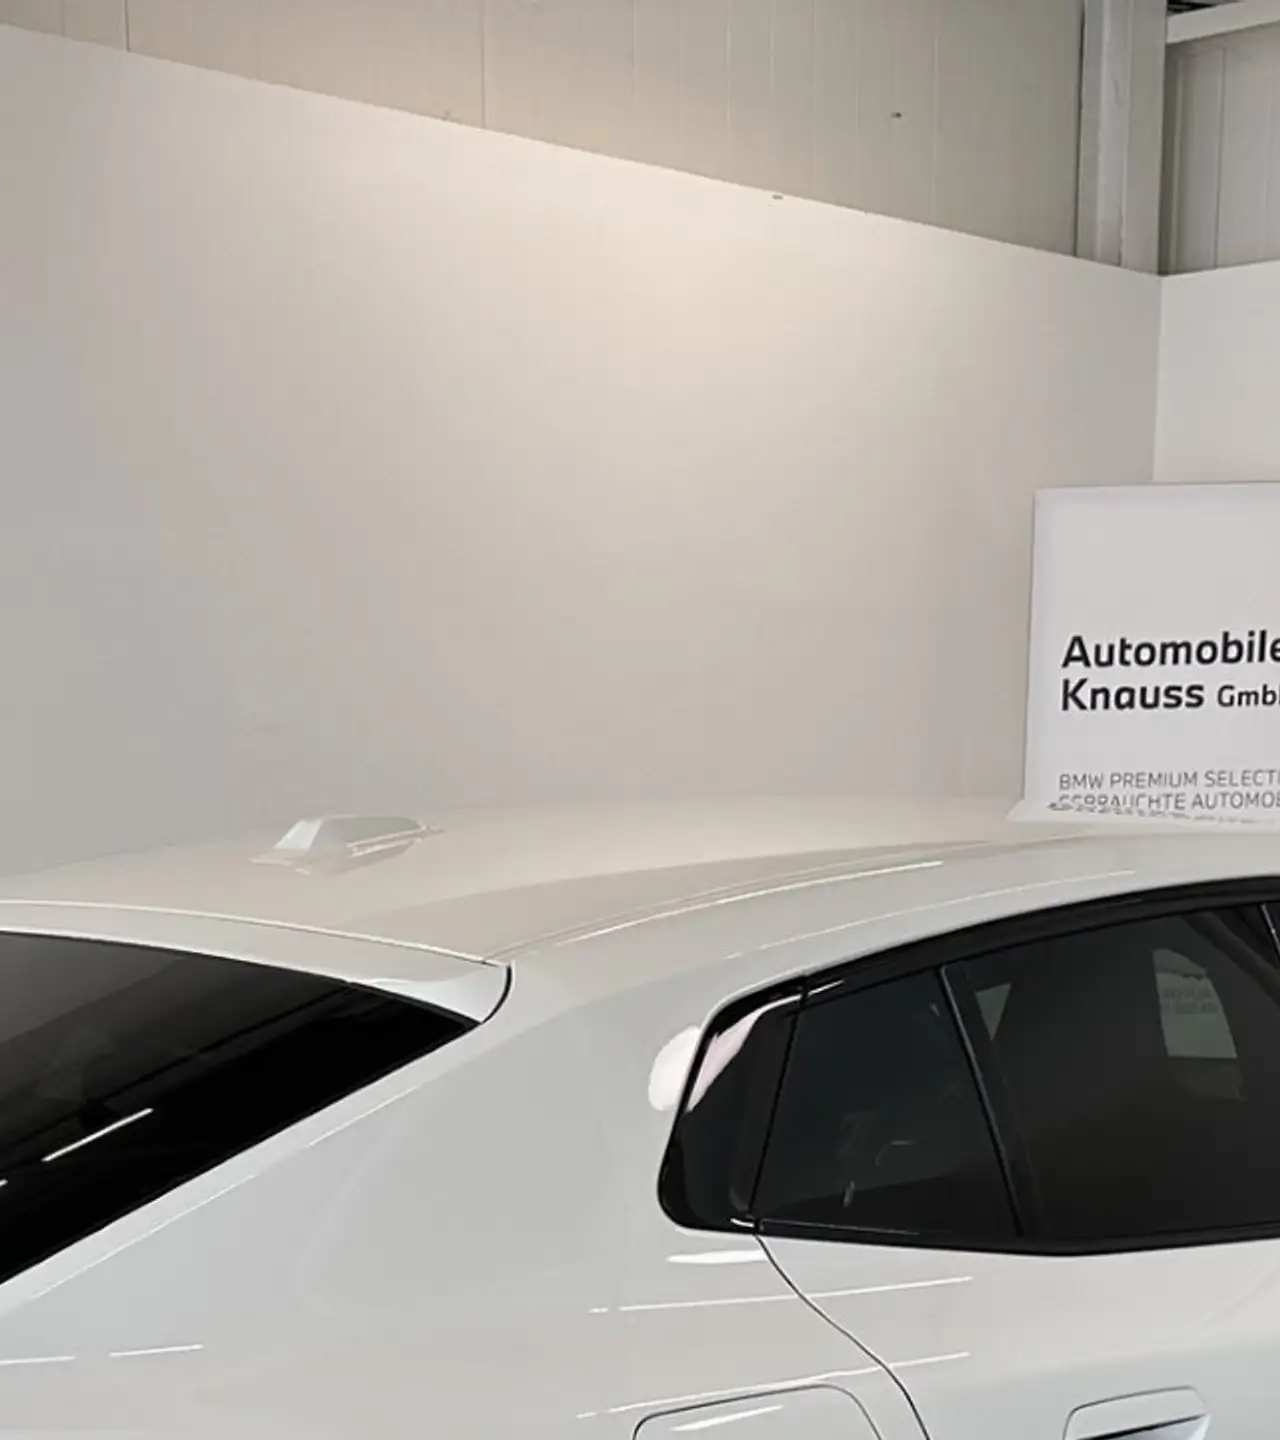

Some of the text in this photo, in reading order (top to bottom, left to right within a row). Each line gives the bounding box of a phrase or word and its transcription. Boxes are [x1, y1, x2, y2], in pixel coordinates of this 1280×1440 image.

[1061, 677, 1205, 712] Knauss
[1059, 772, 1104, 791] BMW
[1109, 771, 1198, 789] PREMIUM
